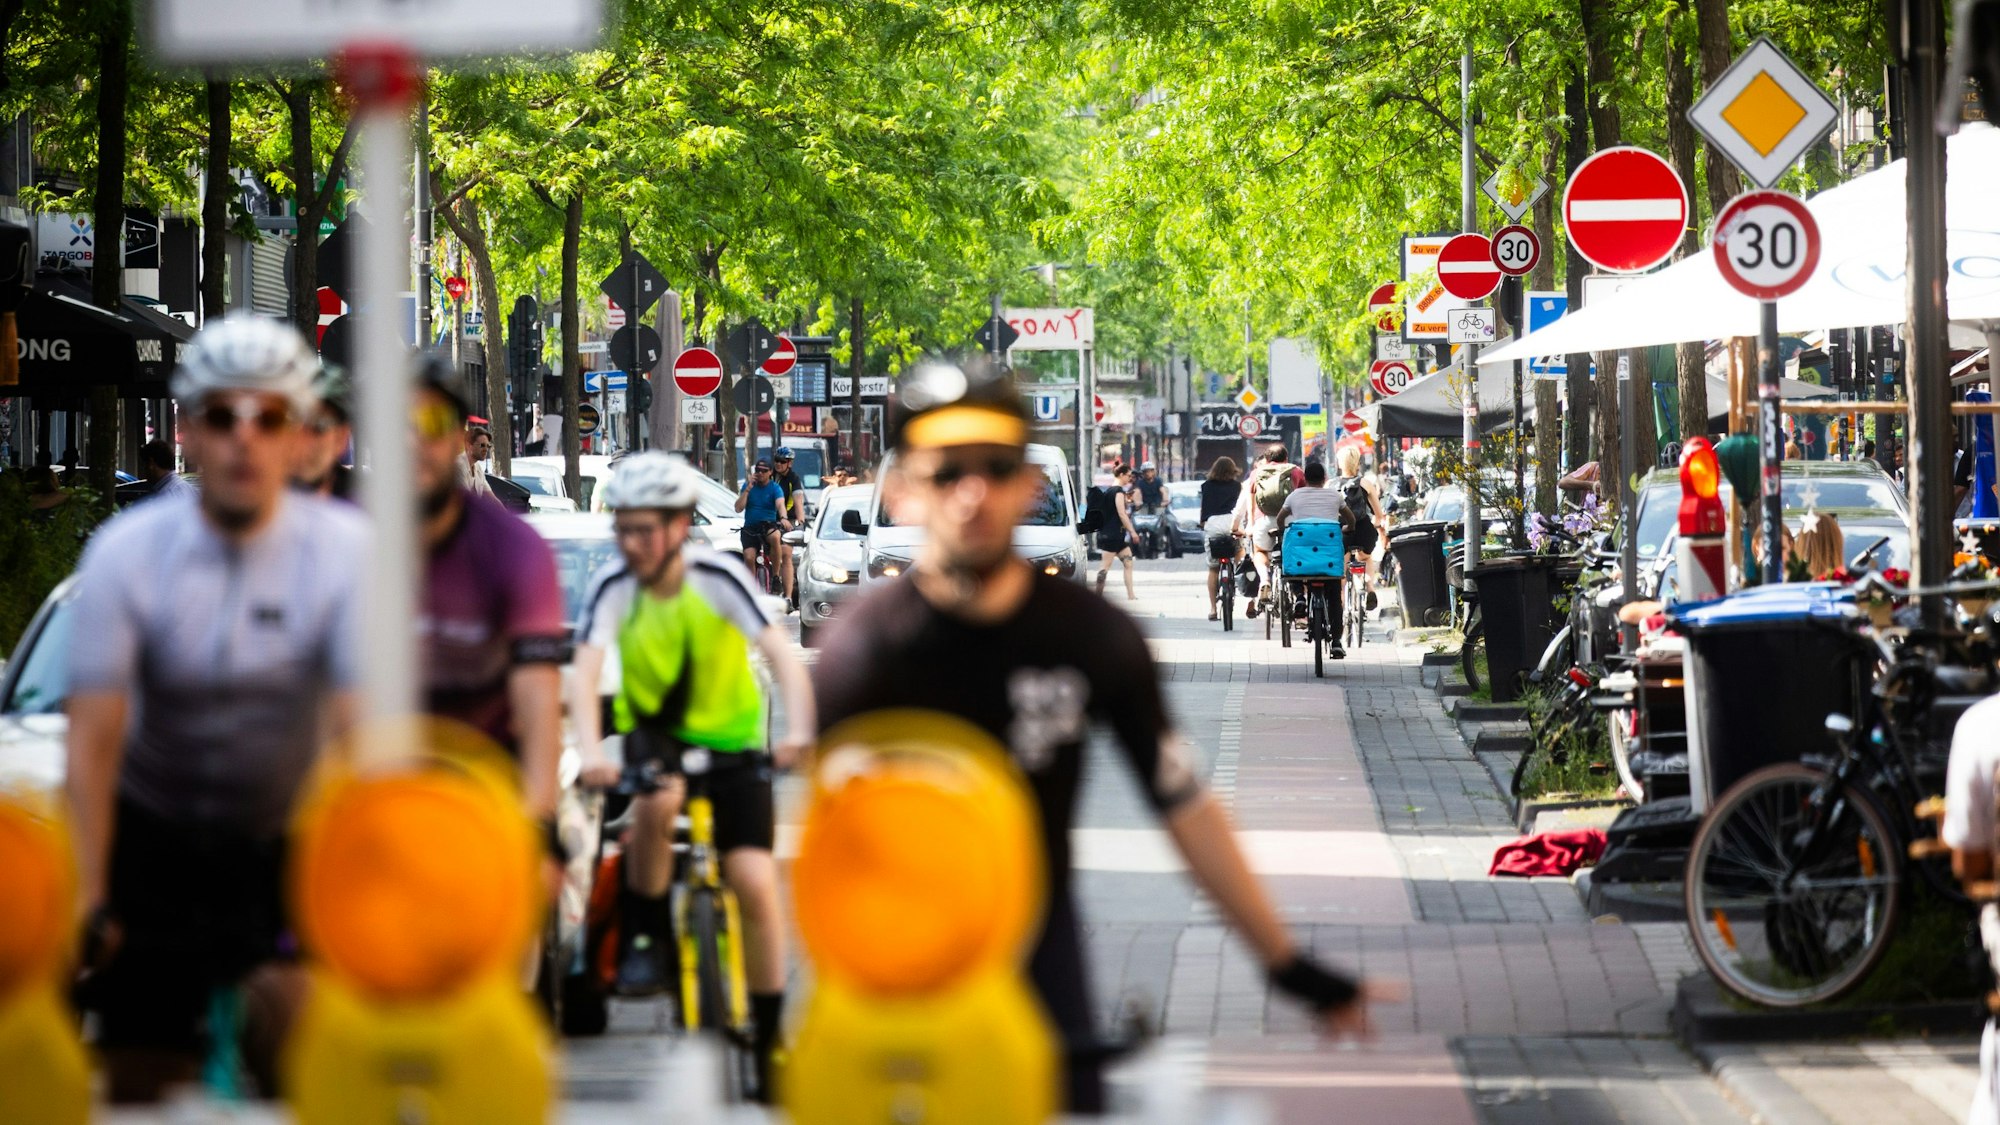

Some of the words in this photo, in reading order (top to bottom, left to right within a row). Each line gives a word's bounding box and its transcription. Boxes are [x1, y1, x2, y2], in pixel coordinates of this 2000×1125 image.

[1501, 239, 1529, 261] 30
[1737, 222, 1797, 269] 30
[1009, 309, 1083, 340] SONY
[1464, 331, 1479, 339] frei
[833, 380, 886, 393] Körerstr.
[1387, 371, 1406, 387] 30
[1036, 397, 1057, 419] U
[784, 421, 813, 433] Dar
[1244, 421, 1257, 432] 30
